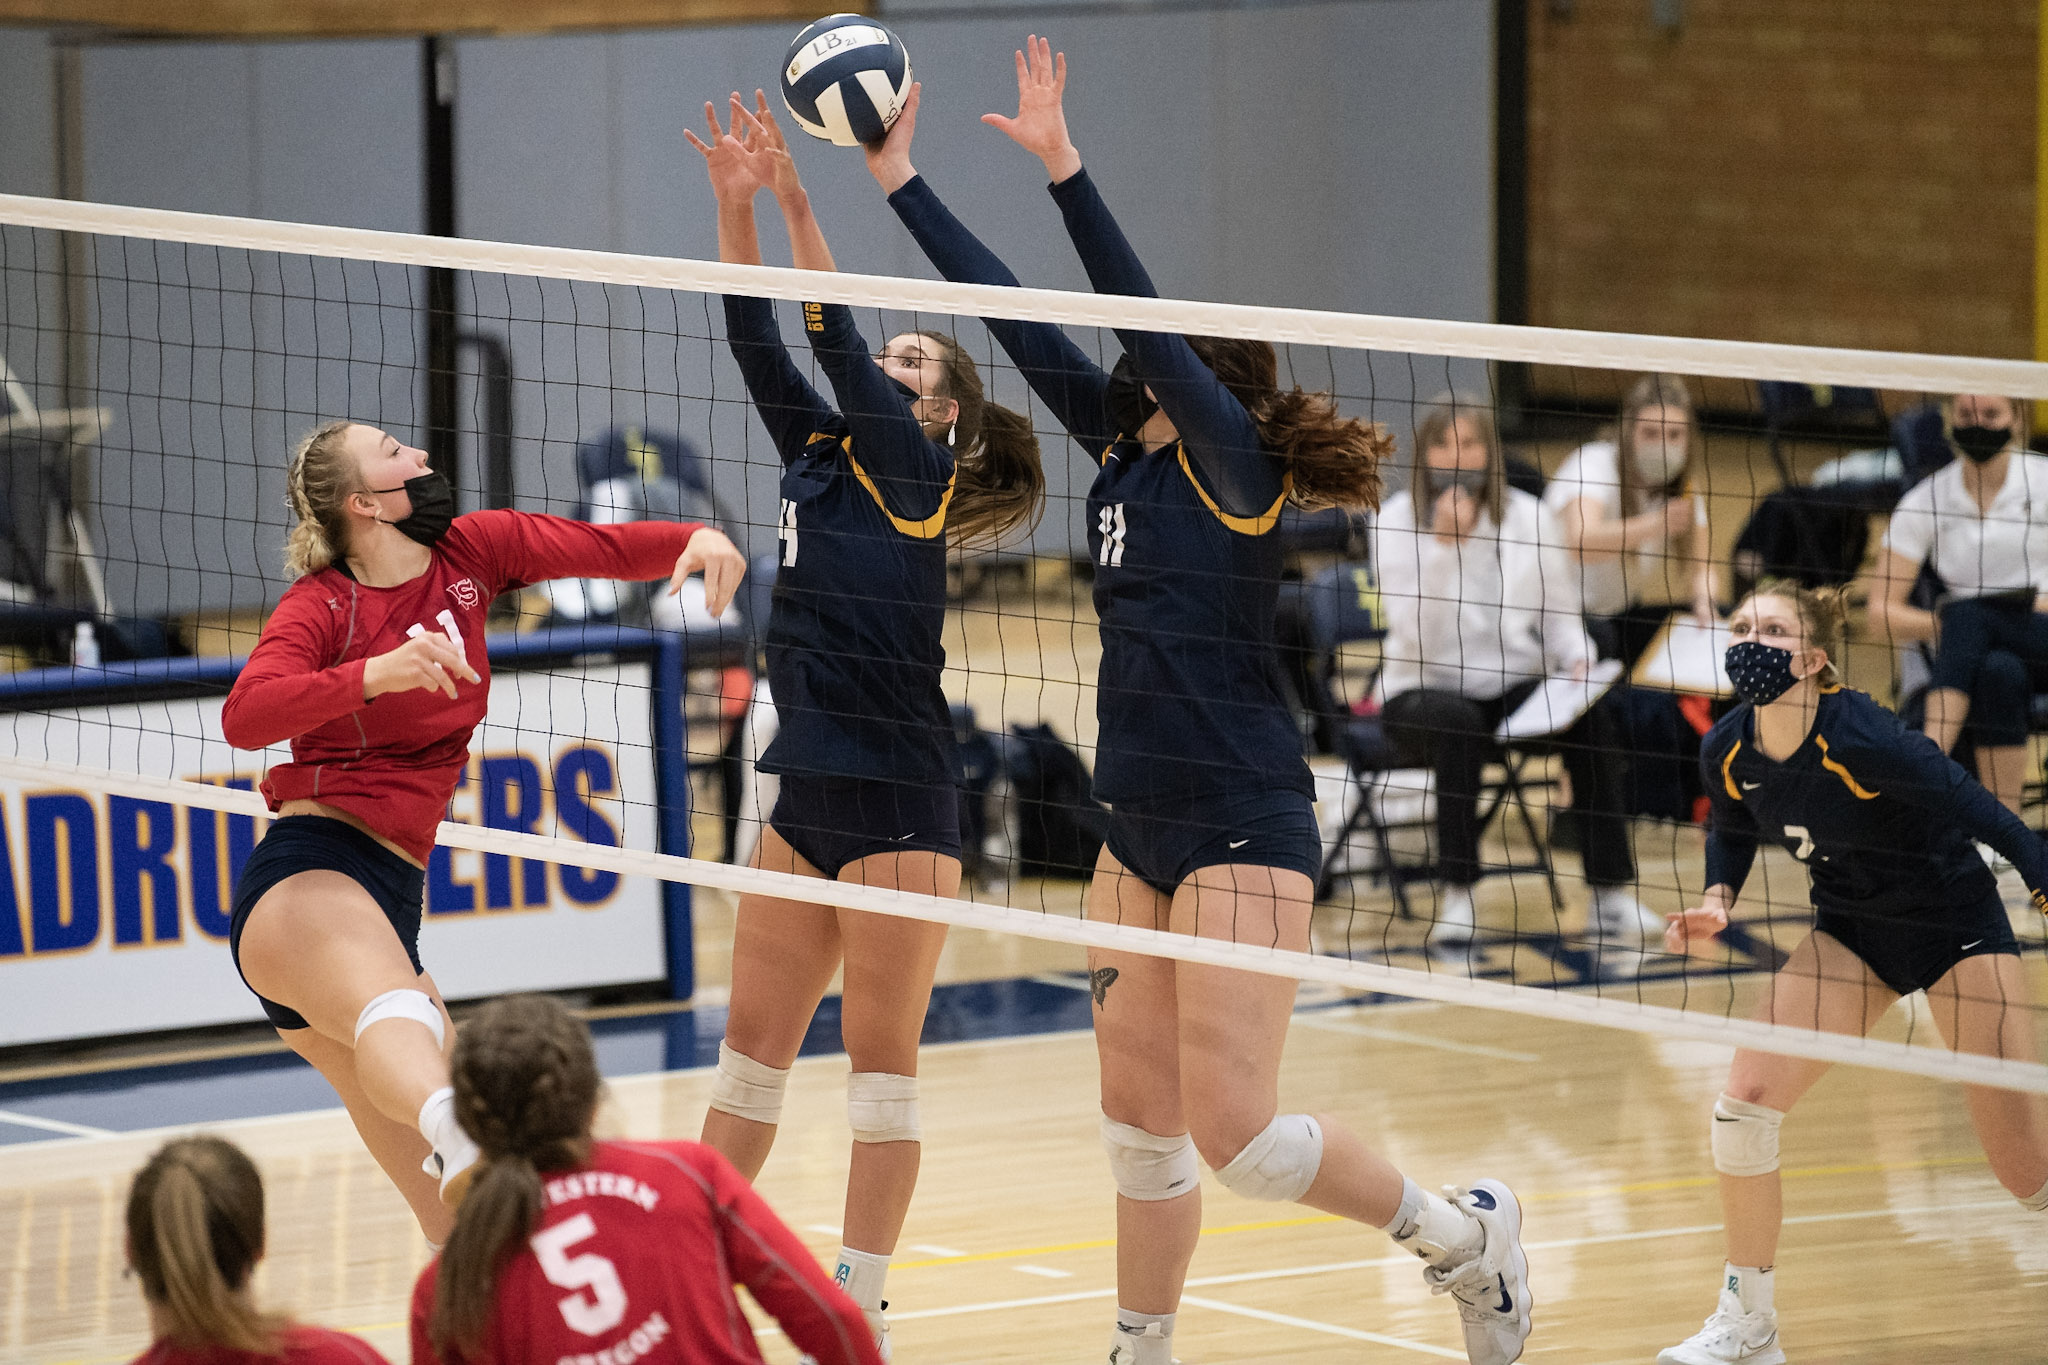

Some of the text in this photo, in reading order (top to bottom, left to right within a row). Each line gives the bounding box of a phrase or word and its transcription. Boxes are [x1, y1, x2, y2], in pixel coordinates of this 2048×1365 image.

[1098, 503, 1126, 567] 11
[544, 1171, 660, 1212] ESTERN
[530, 1213, 628, 1337] 5
